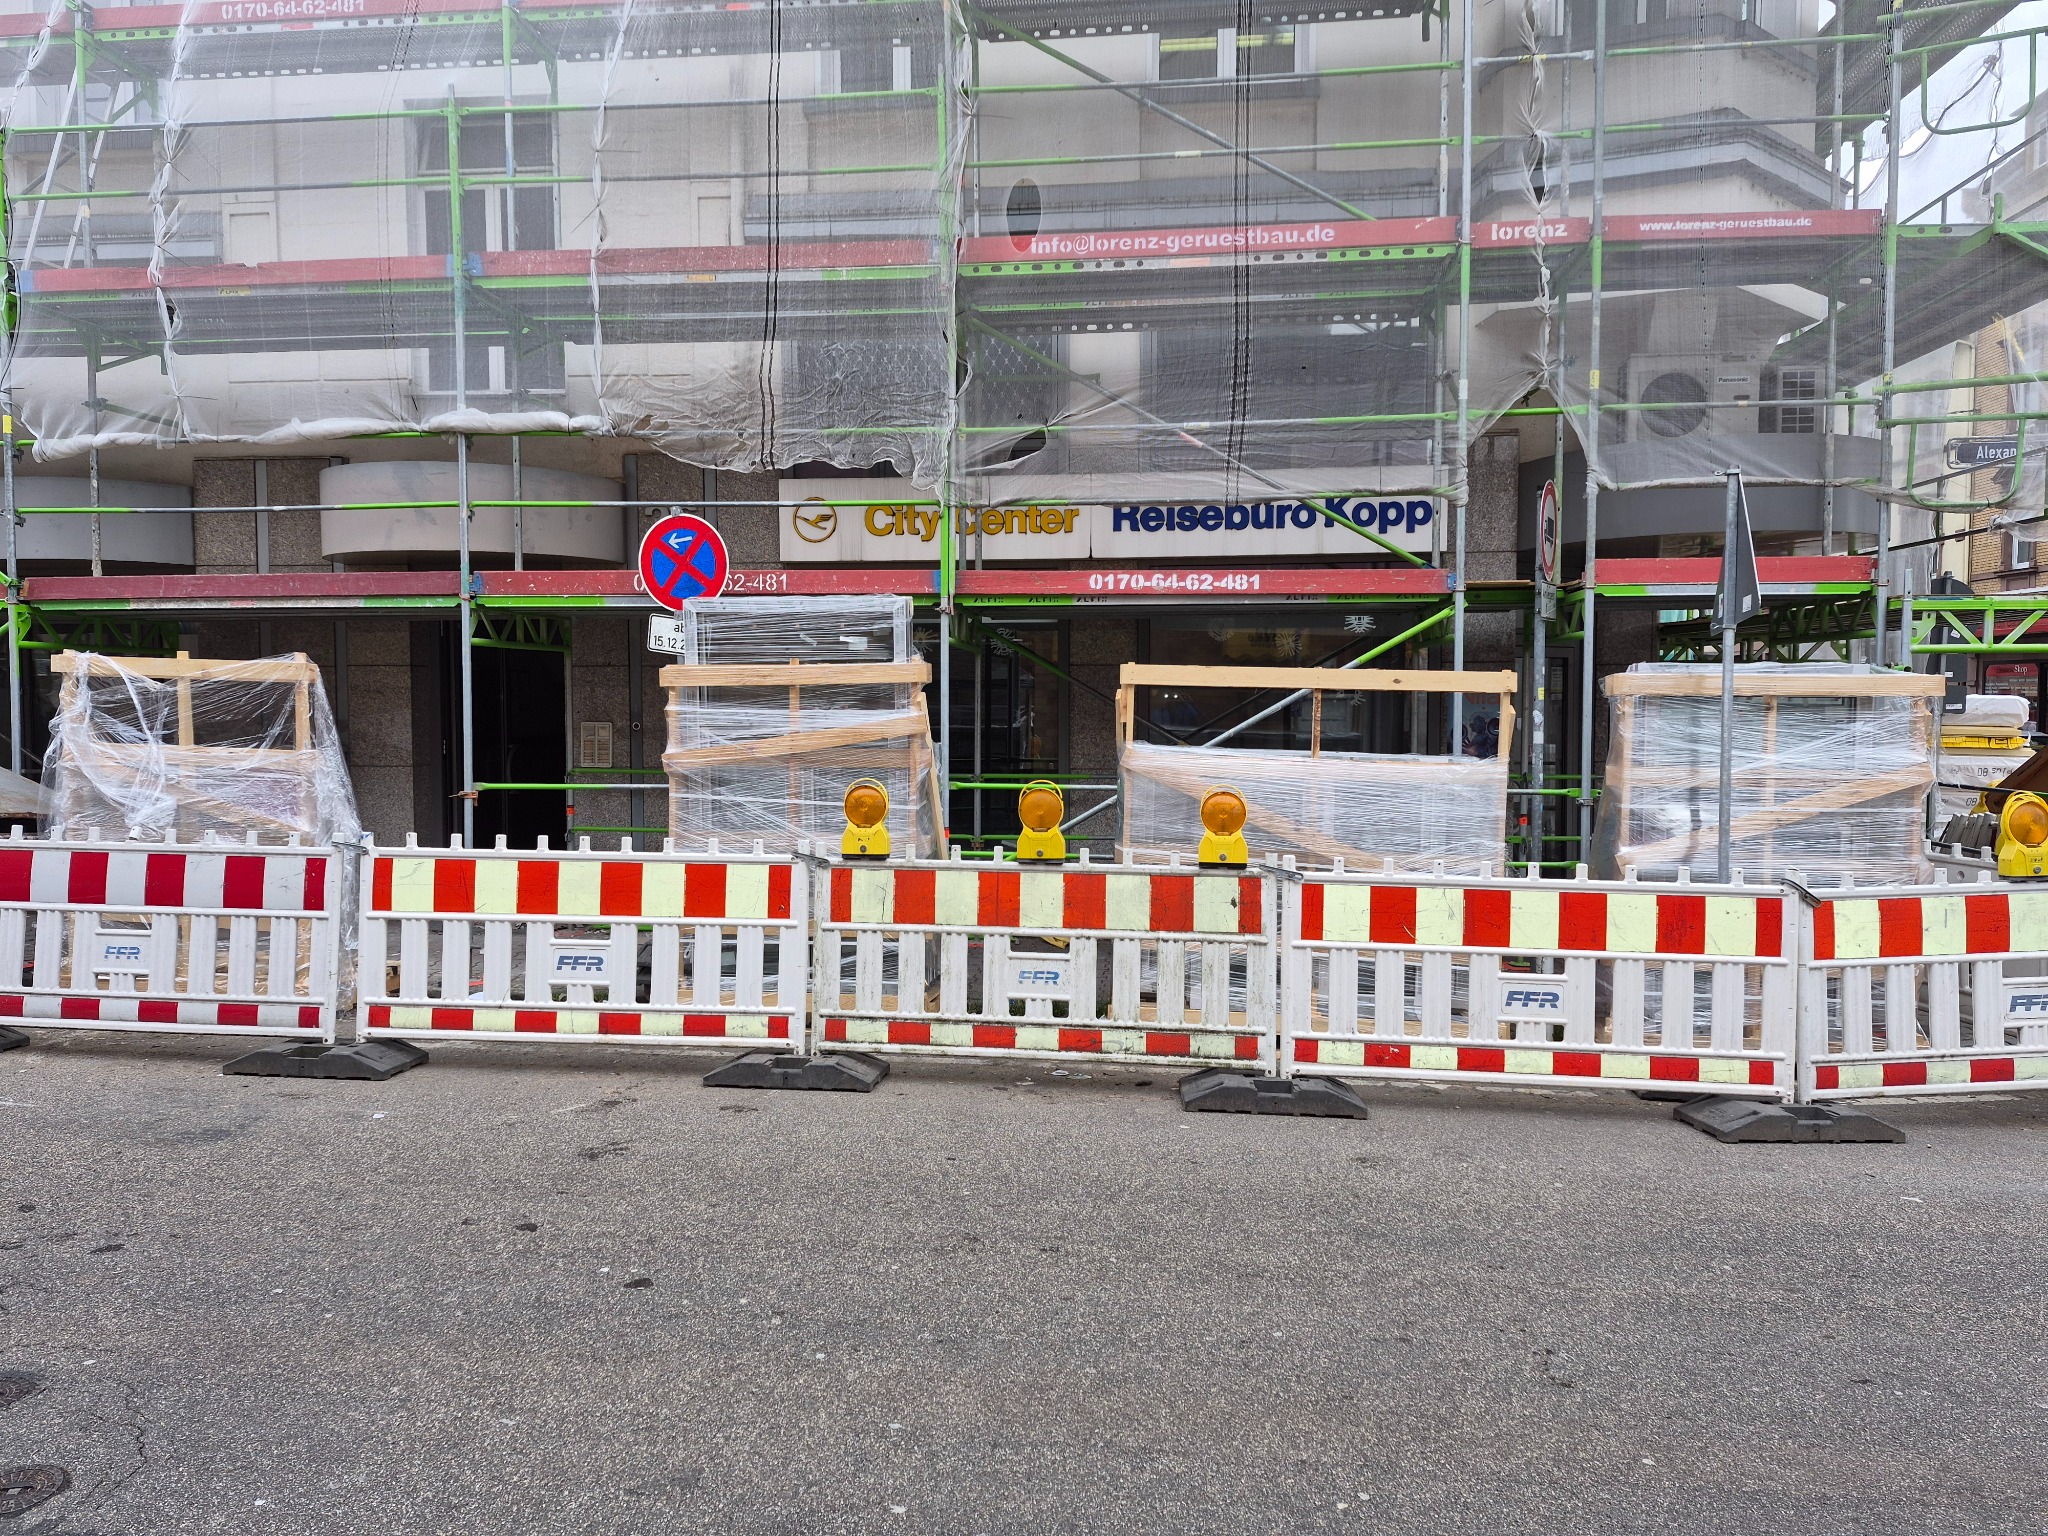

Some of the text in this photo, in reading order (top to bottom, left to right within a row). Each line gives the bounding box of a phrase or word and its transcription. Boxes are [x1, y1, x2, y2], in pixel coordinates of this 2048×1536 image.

[221, 0, 365, 19] 0170-64-62-481
[1031, 224, 1336, 254] info@lorenz-geruestbau.de
[1491, 222, 1568, 241] lorenz
[864, 504, 941, 542] City
[1324, 497, 1433, 535] Kopp
[1088, 573, 1260, 591] 0170-64-62-481
[103, 945, 142, 960] FFR
[556, 955, 605, 972] FFR
[1017, 970, 1061, 986] FFR
[1504, 990, 1560, 1009] FFR
